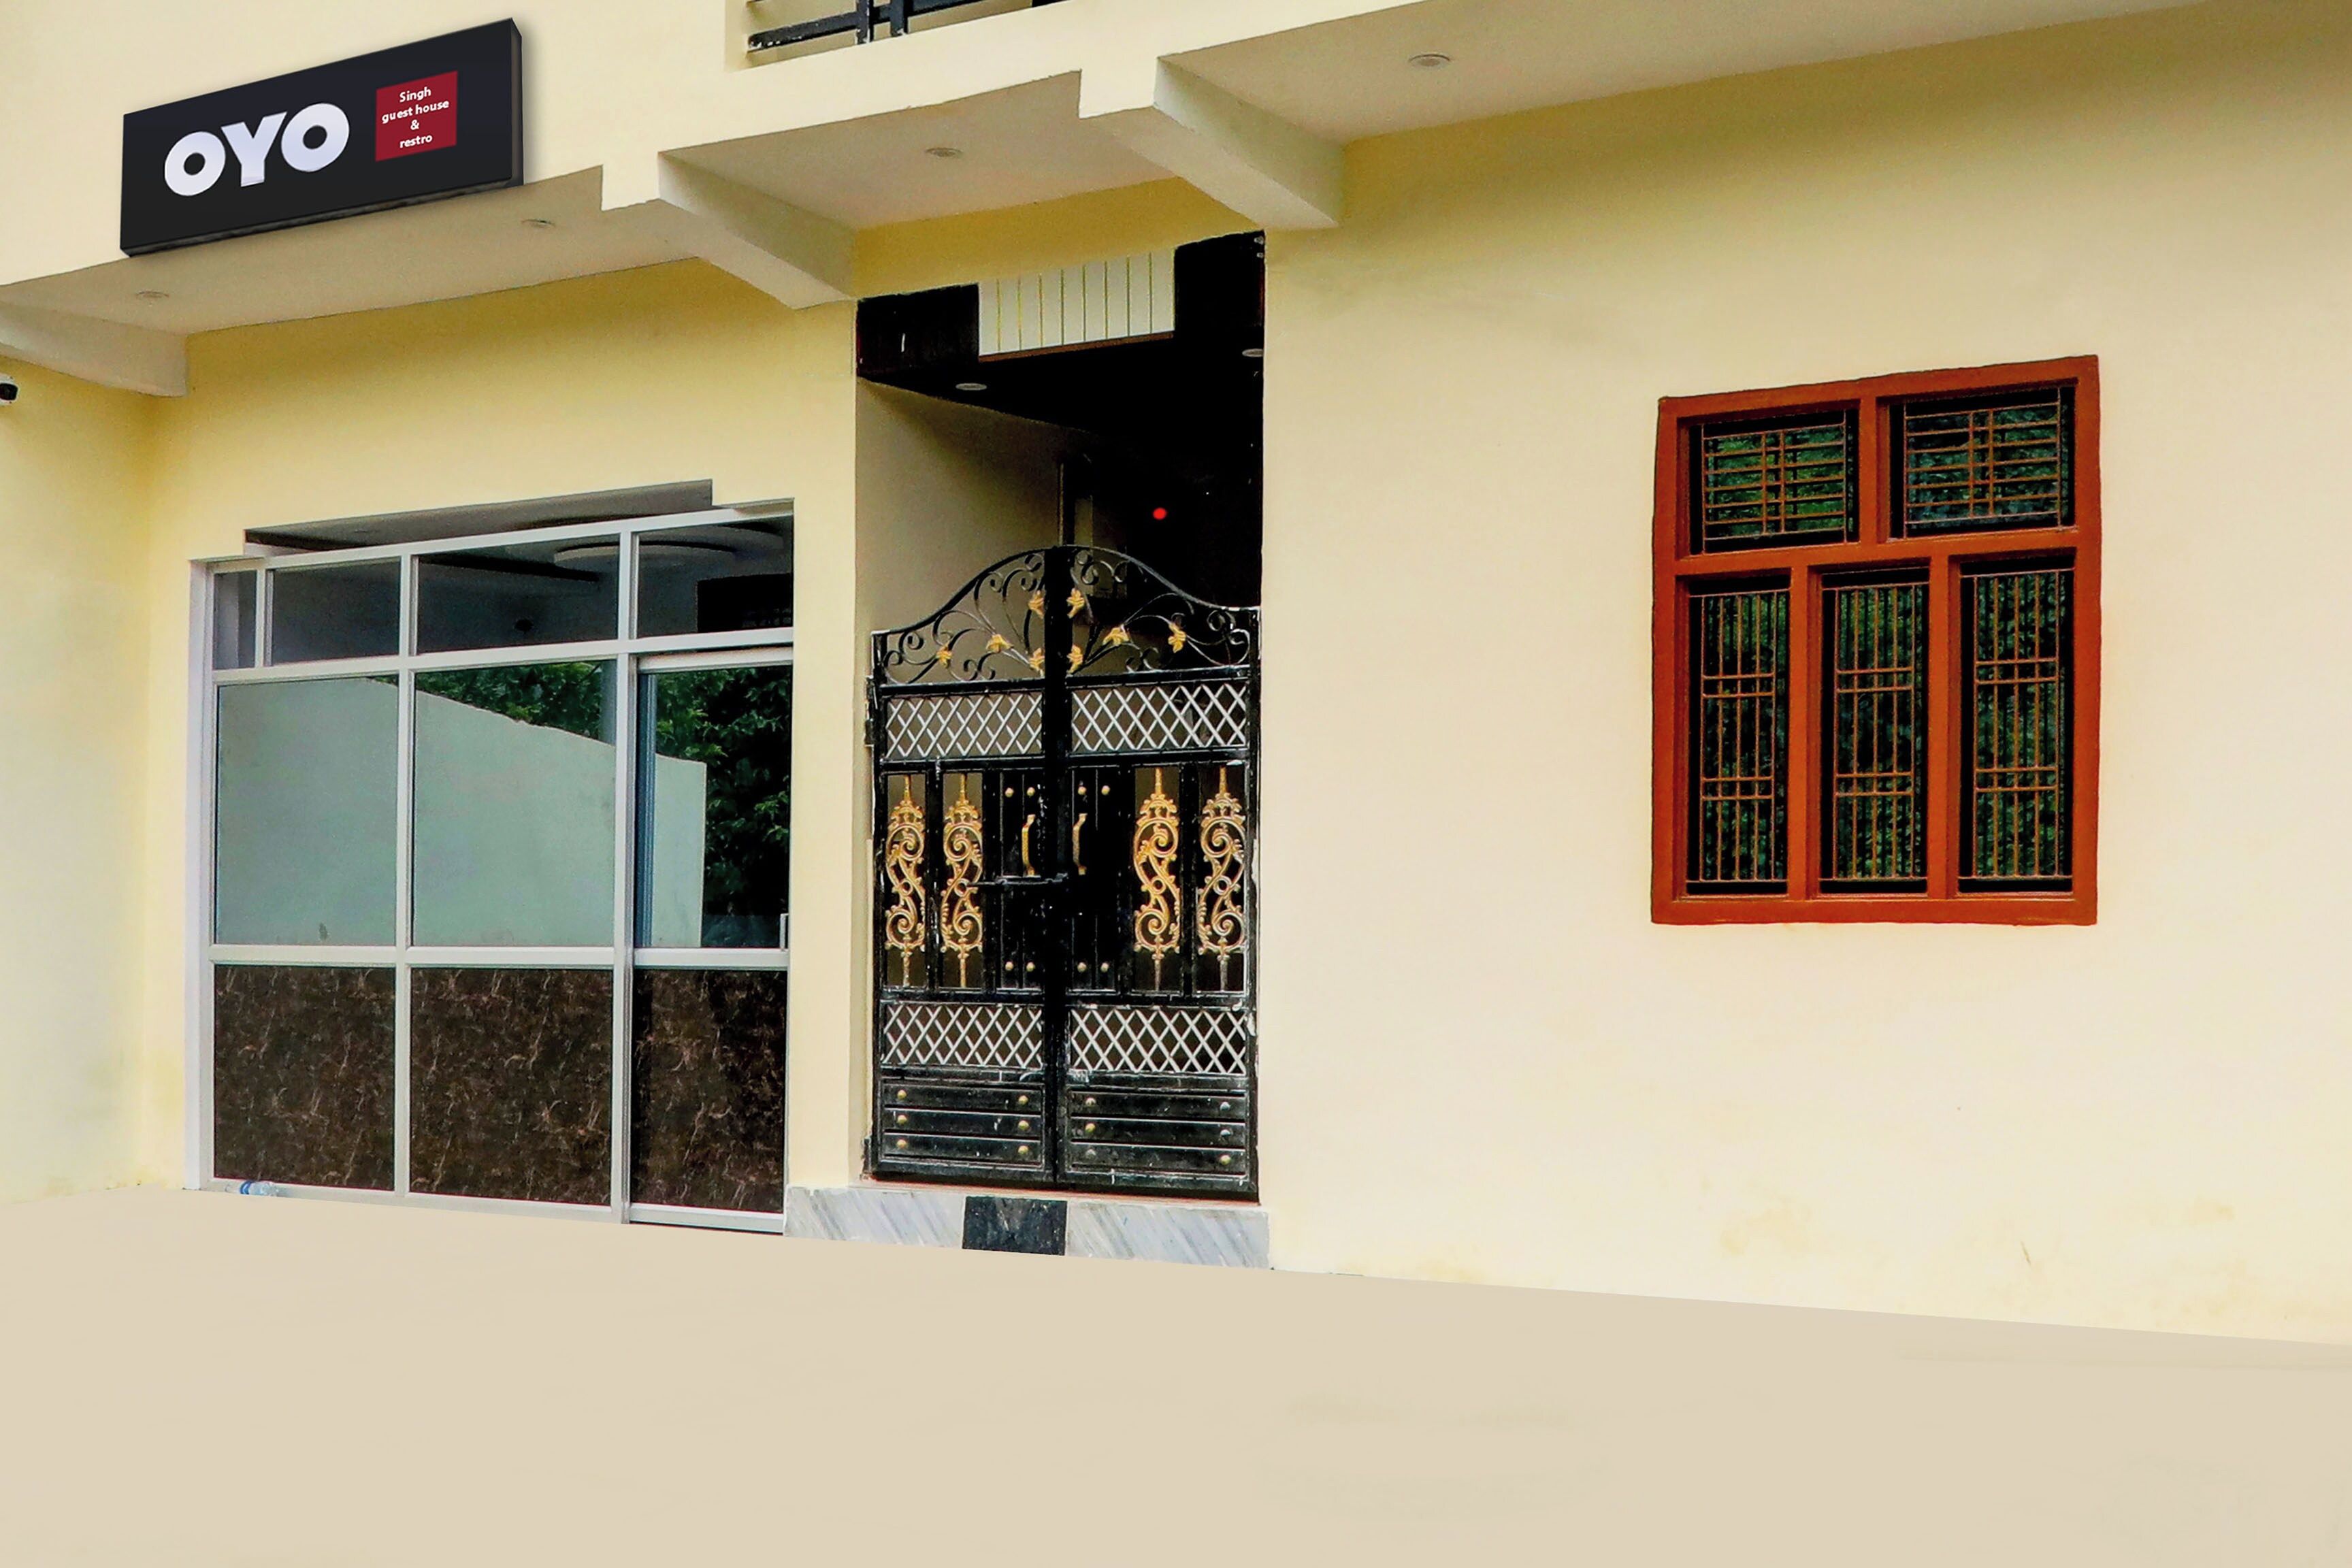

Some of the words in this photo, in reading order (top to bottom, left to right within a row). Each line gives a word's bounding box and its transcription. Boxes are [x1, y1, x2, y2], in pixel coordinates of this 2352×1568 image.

[399, 86, 431, 103] Singh
[382, 107, 413, 124] guest
[415, 101, 449, 115] house
[410, 119, 420, 130] &
[165, 103, 350, 197] OYO
[399, 135, 433, 148] restro
